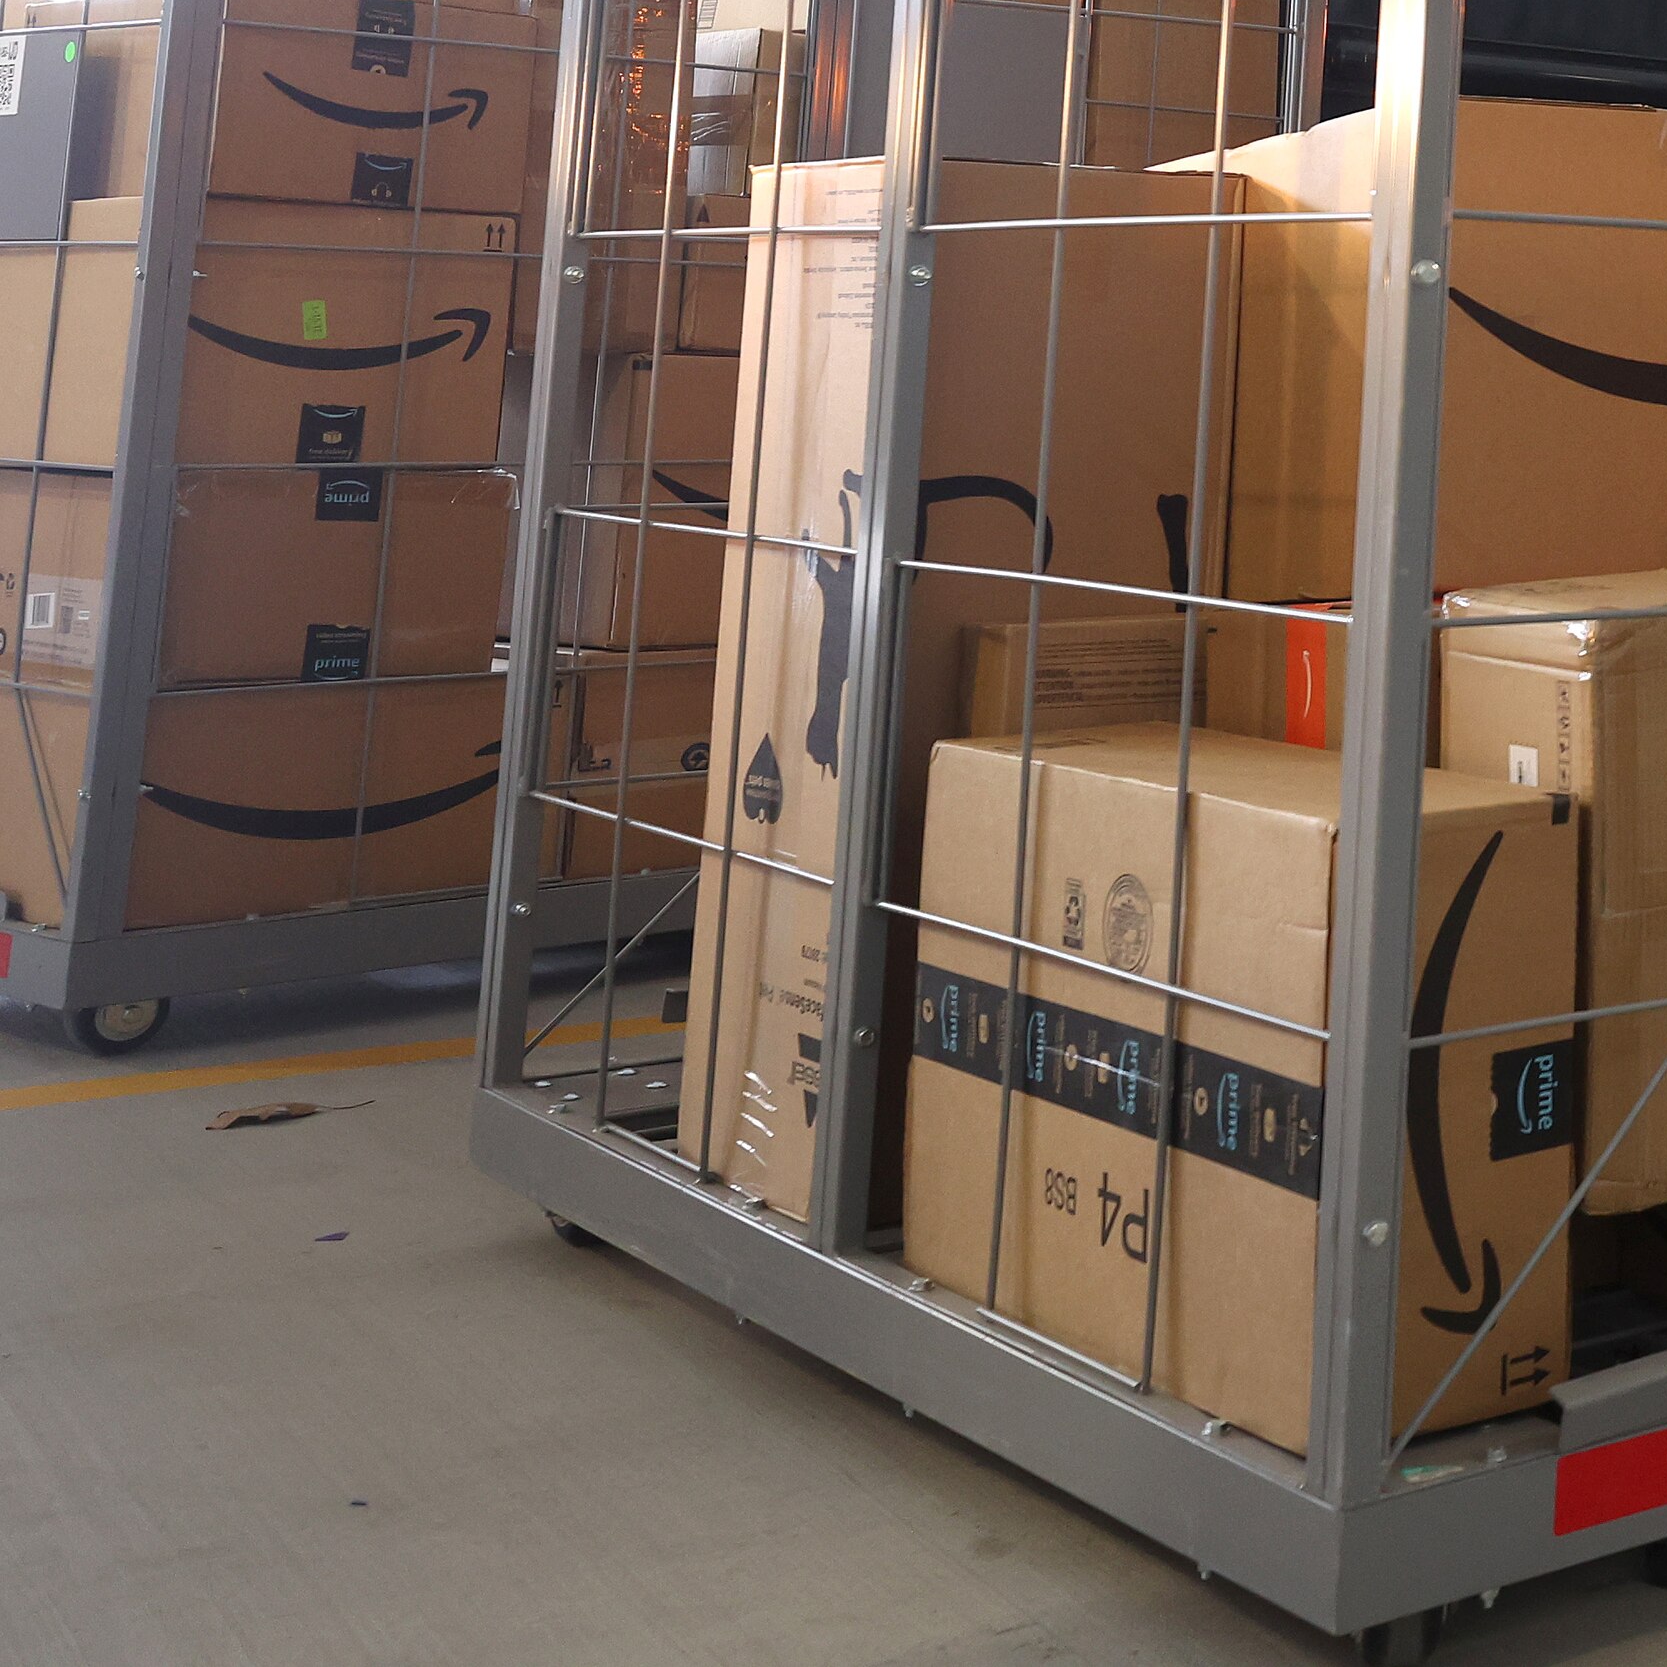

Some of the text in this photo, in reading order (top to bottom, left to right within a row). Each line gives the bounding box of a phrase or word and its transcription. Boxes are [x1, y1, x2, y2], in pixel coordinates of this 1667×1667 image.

[324, 491, 370, 507] prime
[314, 654, 360, 672] prime
[949, 985, 959, 1052] prime
[1036, 1011, 1046, 1082] prime
[1226, 1073, 1239, 1150] prime
[1534, 1054, 1559, 1130] prime
[1098, 1171, 1149, 1263] P4
